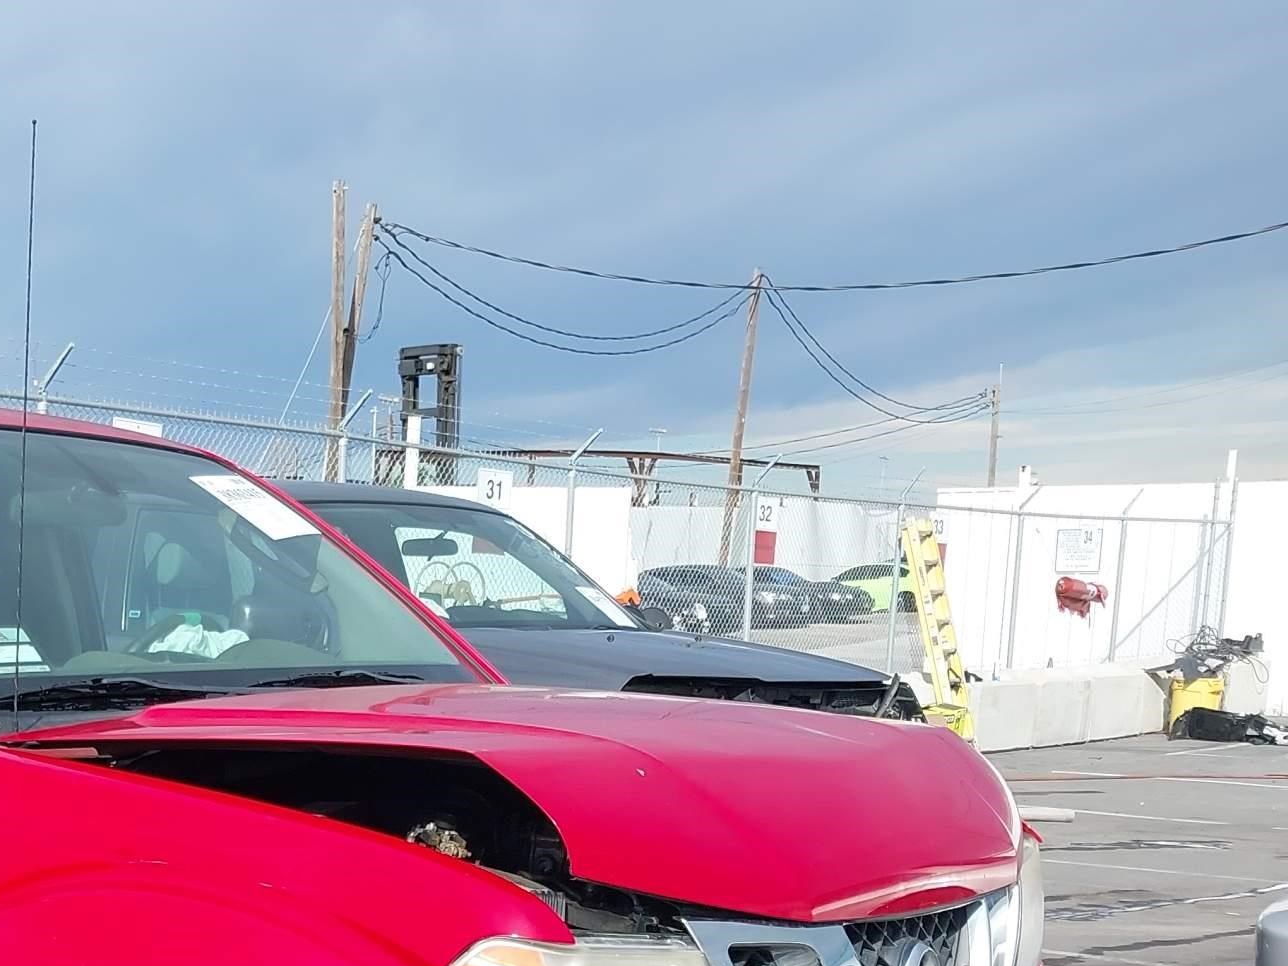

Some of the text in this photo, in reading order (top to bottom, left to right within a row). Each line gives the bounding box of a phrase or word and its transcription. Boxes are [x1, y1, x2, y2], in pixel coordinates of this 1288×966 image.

[486, 479, 502, 501] 31
[759, 504, 773, 522] 32
[933, 519, 944, 535] 33
